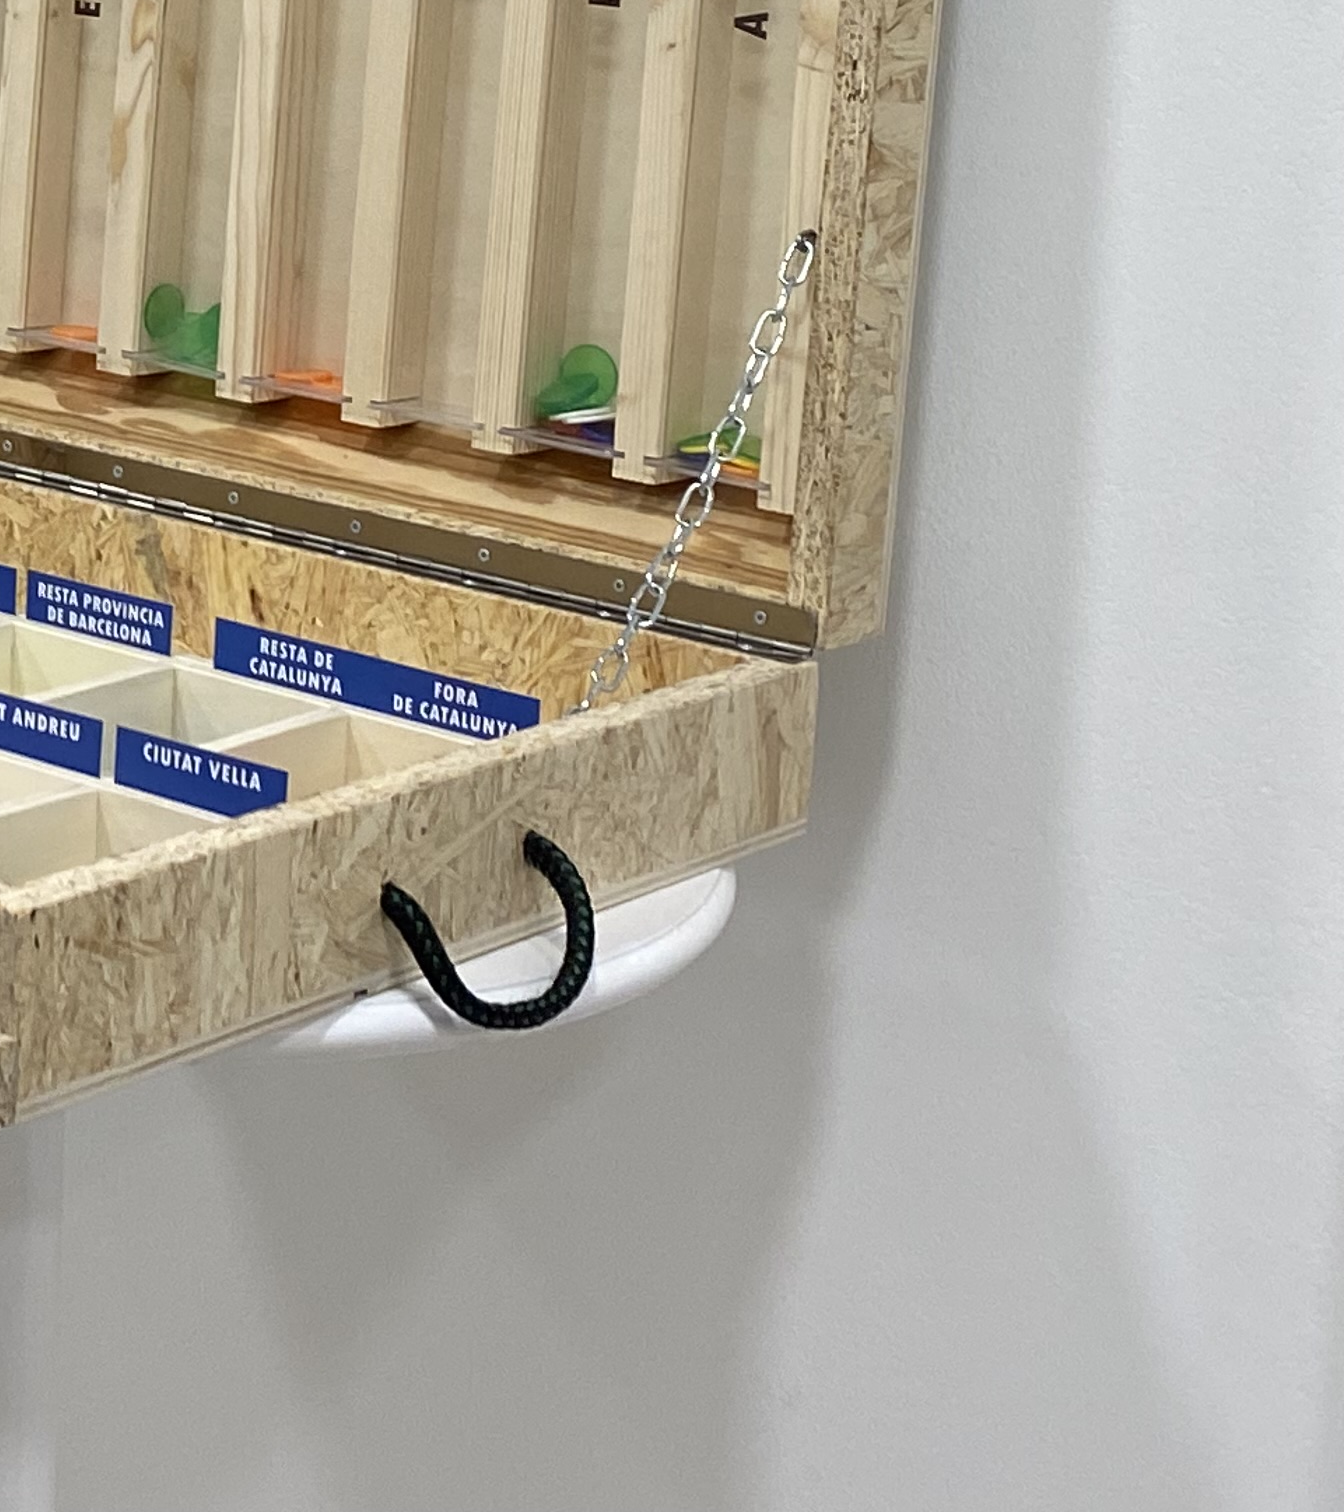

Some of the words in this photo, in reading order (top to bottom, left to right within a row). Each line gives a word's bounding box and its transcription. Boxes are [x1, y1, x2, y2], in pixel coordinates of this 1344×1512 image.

[733, 11, 769, 41] A
[37, 581, 81, 610] RESTA
[82, 593, 165, 630] PROVINCIA
[46, 604, 67, 625] DE
[68, 609, 153, 649] BARCELONA
[259, 635, 309, 667] RESTA
[314, 648, 335, 670] DE
[249, 655, 344, 698] CATALUNYA
[433, 680, 479, 709] FORA
[12, 704, 82, 744] ANDREU
[392, 692, 414, 716] DE
[142, 740, 203, 777] CIUTAT
[208, 753, 263, 794] VELLA
